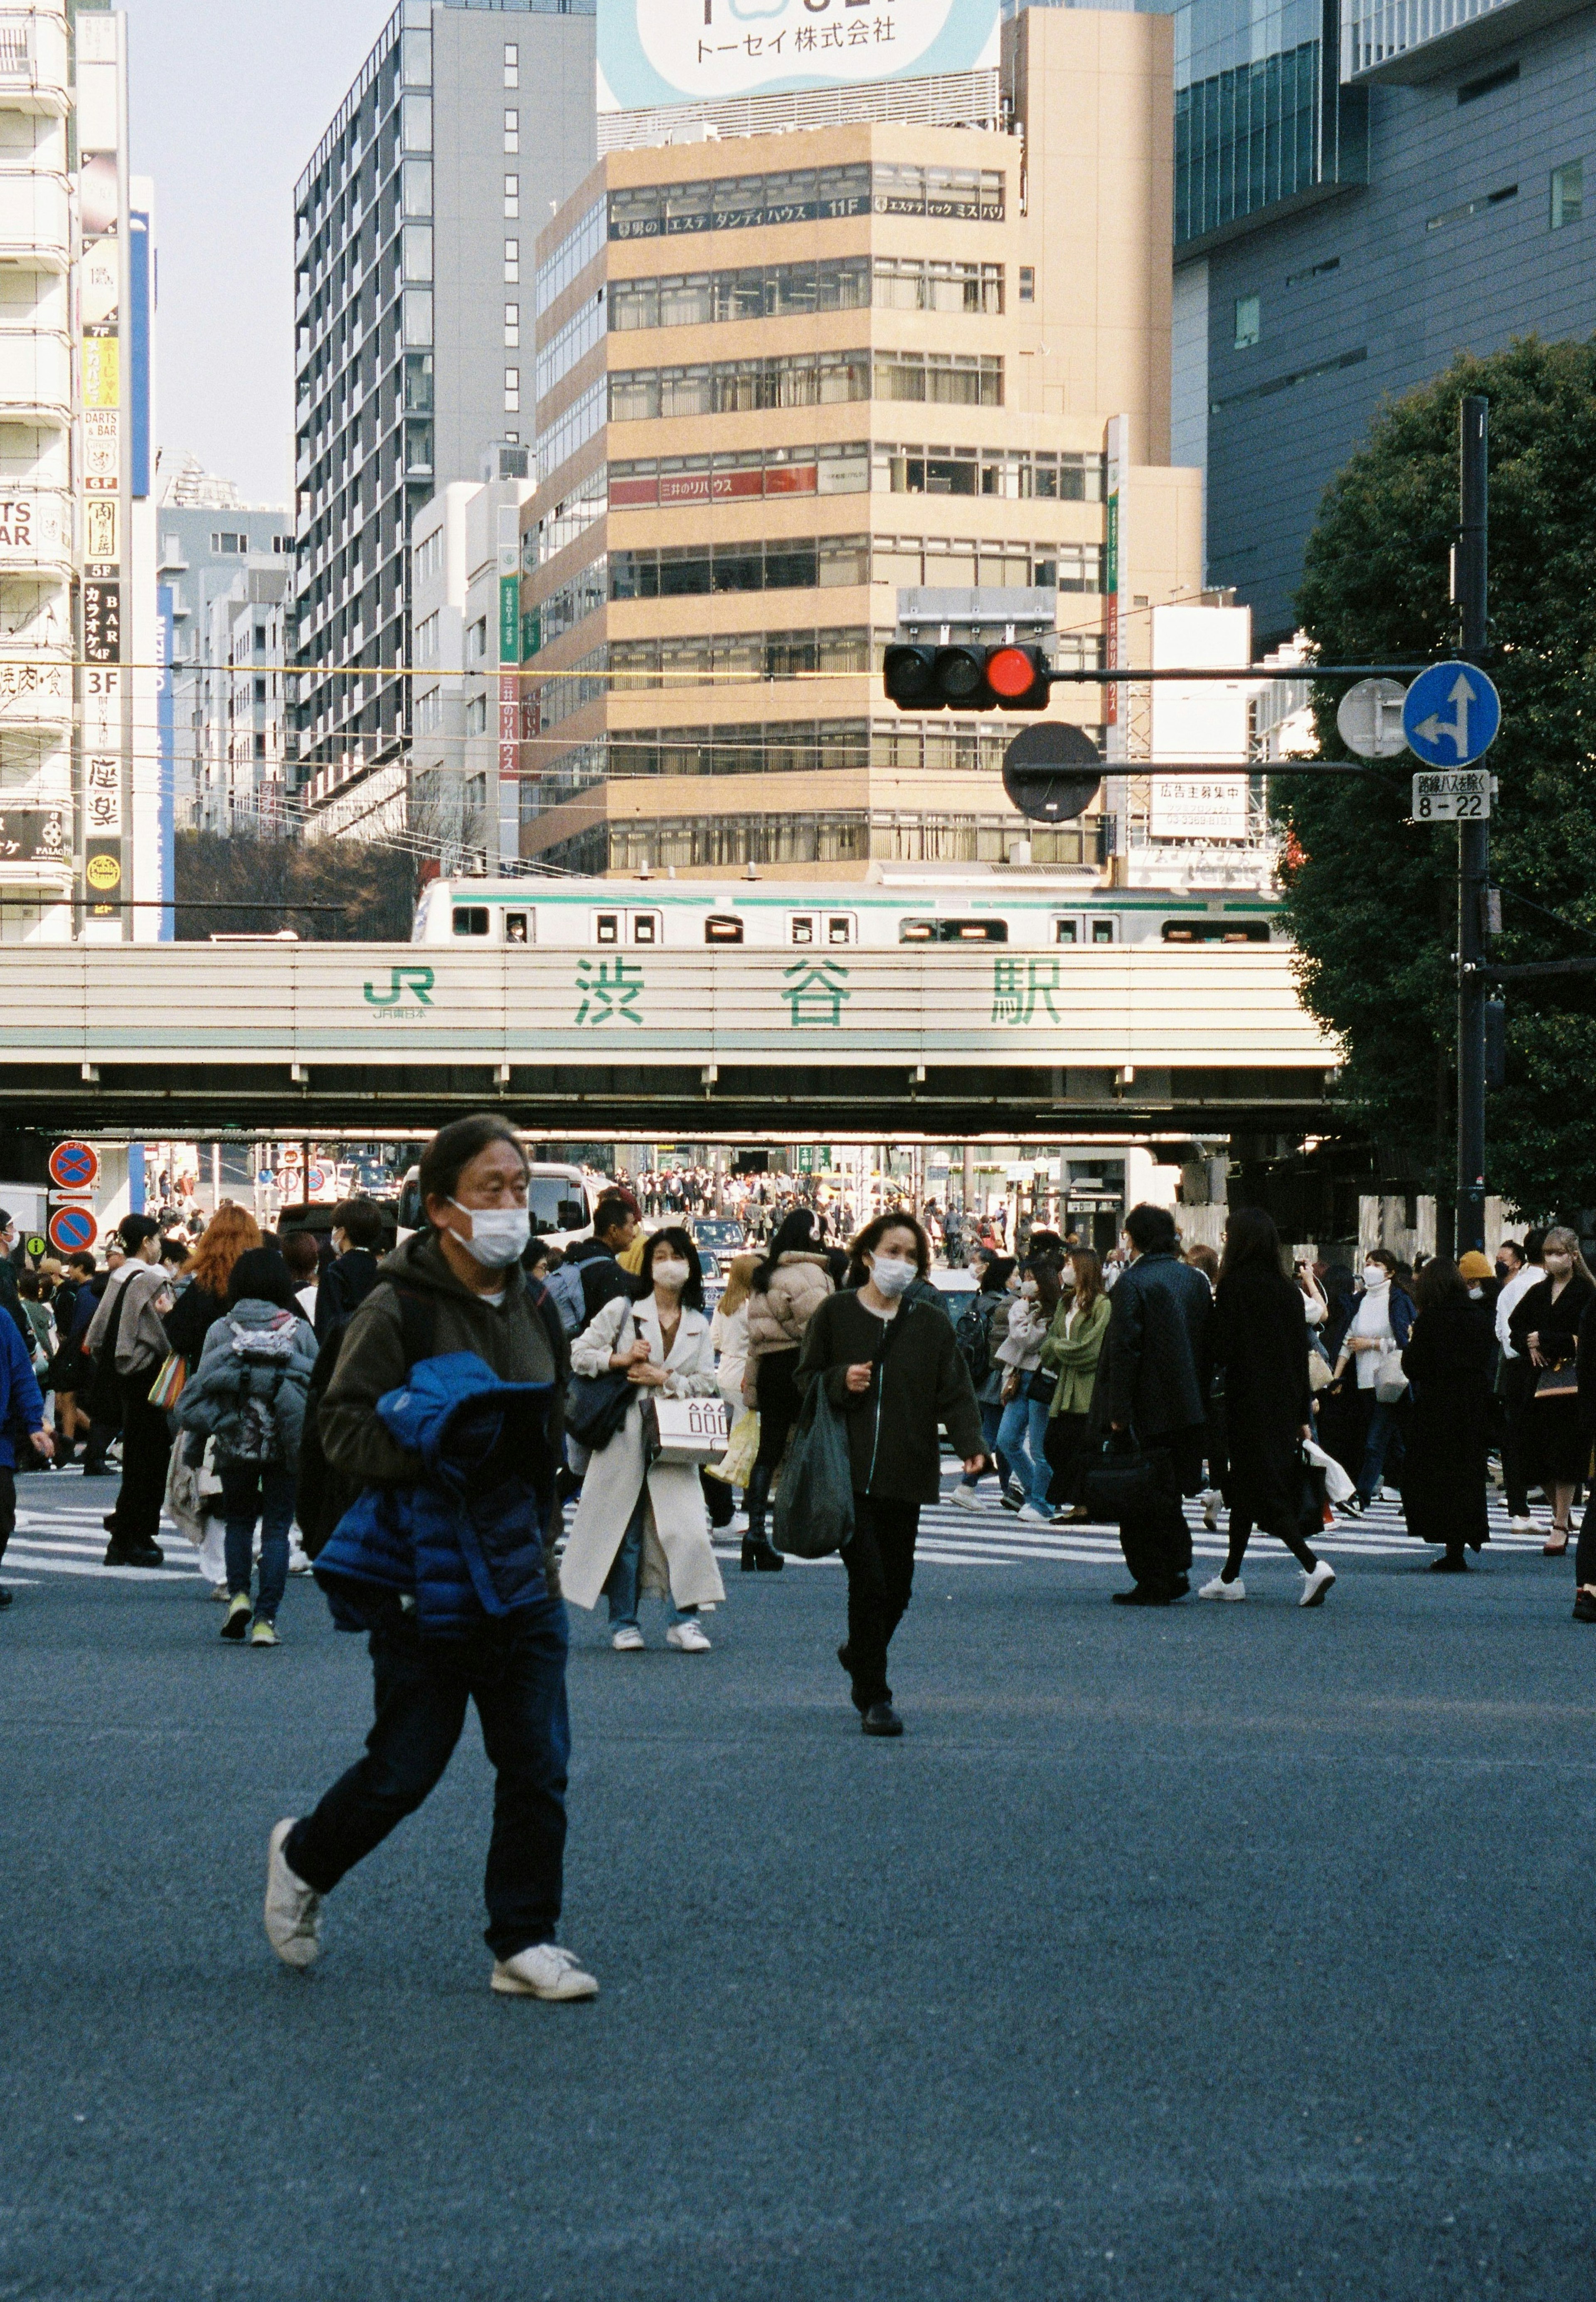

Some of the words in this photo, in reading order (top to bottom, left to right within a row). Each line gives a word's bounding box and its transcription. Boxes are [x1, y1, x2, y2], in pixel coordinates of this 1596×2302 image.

[830, 199, 858, 216] 11F
[91, 326, 109, 337] 7F
[85, 412, 116, 424] DARTS
[98, 425, 116, 436] BAR
[90, 478, 113, 489] 6F
[662, 479, 732, 496] 三井のリハウス
[91, 565, 111, 577] 5F
[86, 587, 100, 649] カラオケ
[106, 596, 118, 643] BAR
[95, 649, 110, 659] 4F
[89, 672, 117, 693] 3F
[503, 677, 514, 769] 三井のリハウス
[1160, 782, 1239, 799] 広告主募集中
[1418, 773, 1485, 793] 路線バスを除く
[363, 966, 435, 1006] JR
[574, 956, 1061, 1026] 渋谷駅
[373, 1008, 426, 1019] JR東日本
